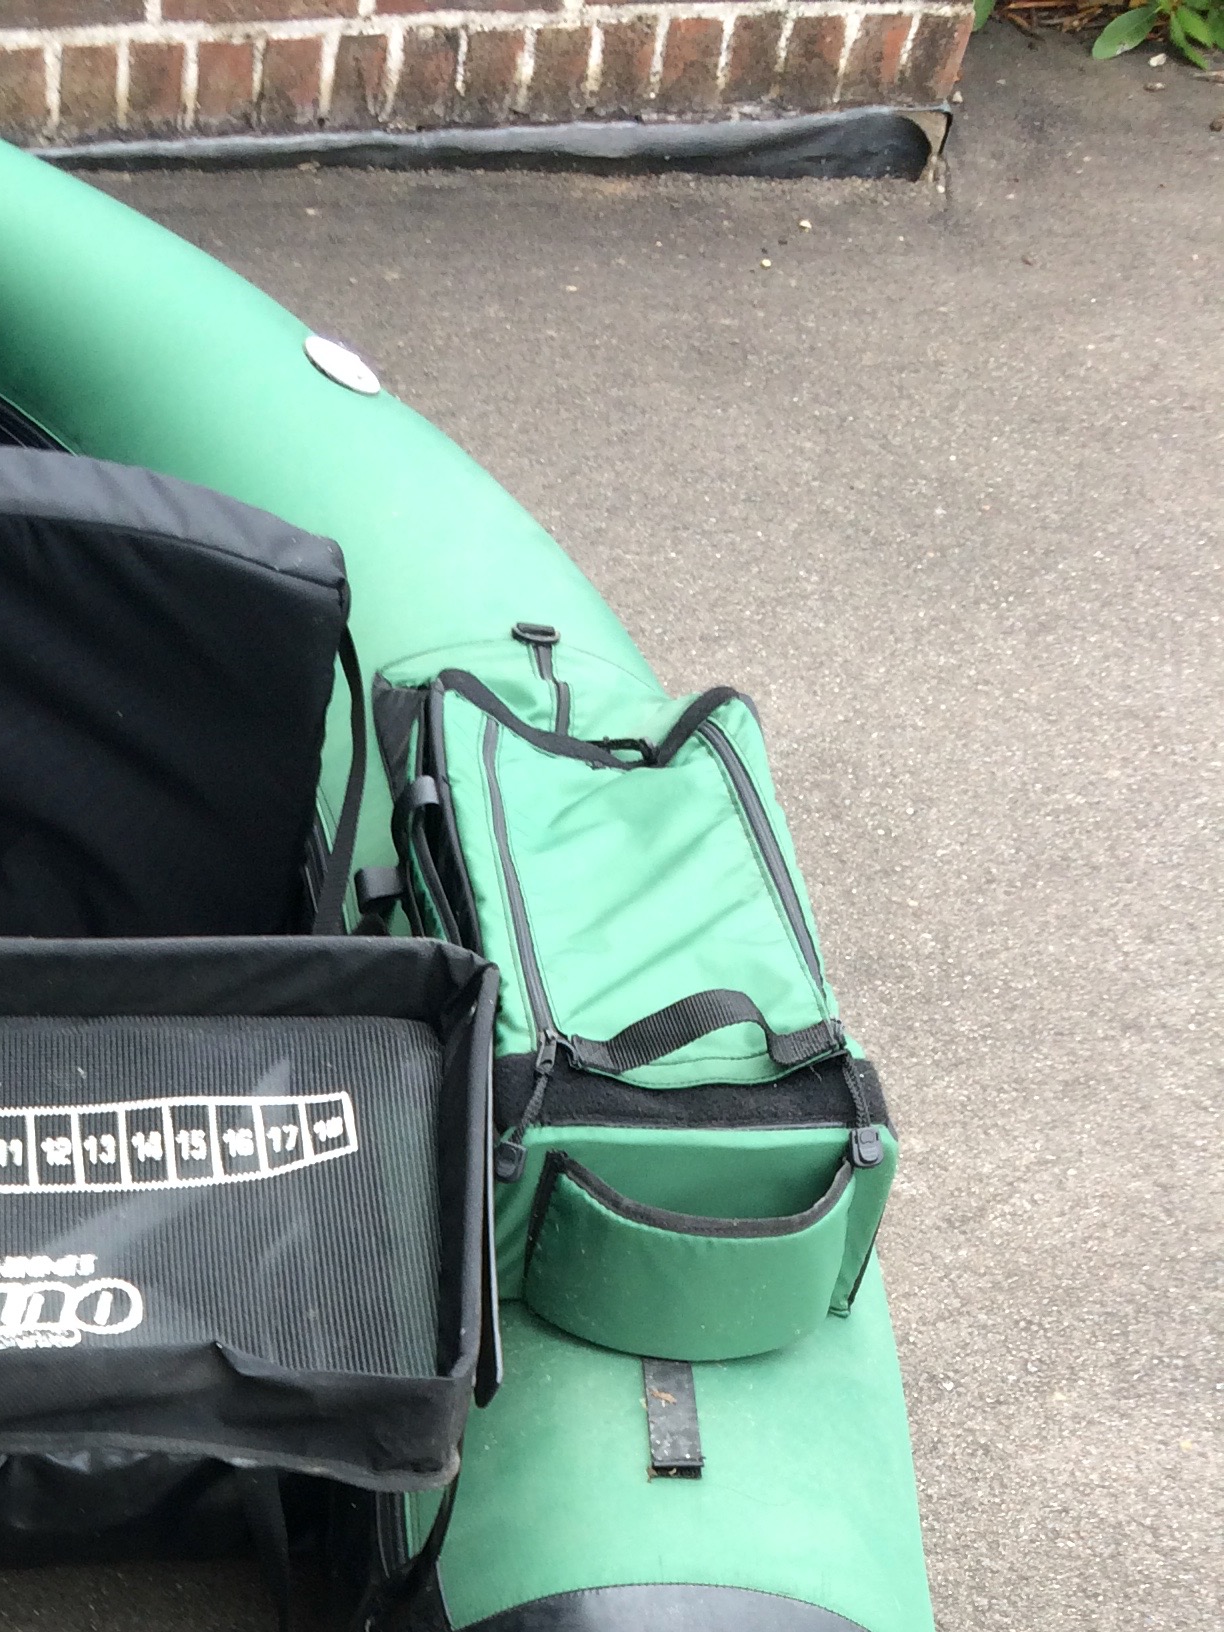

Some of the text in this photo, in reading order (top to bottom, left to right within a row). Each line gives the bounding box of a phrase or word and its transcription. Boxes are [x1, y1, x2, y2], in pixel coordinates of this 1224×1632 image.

[41, 1136, 73, 1167] 12
[83, 1132, 116, 1165] 13
[131, 1130, 163, 1162] 14
[175, 1128, 207, 1161] 15
[222, 1127, 254, 1158] 16
[266, 1124, 299, 1153] 17
